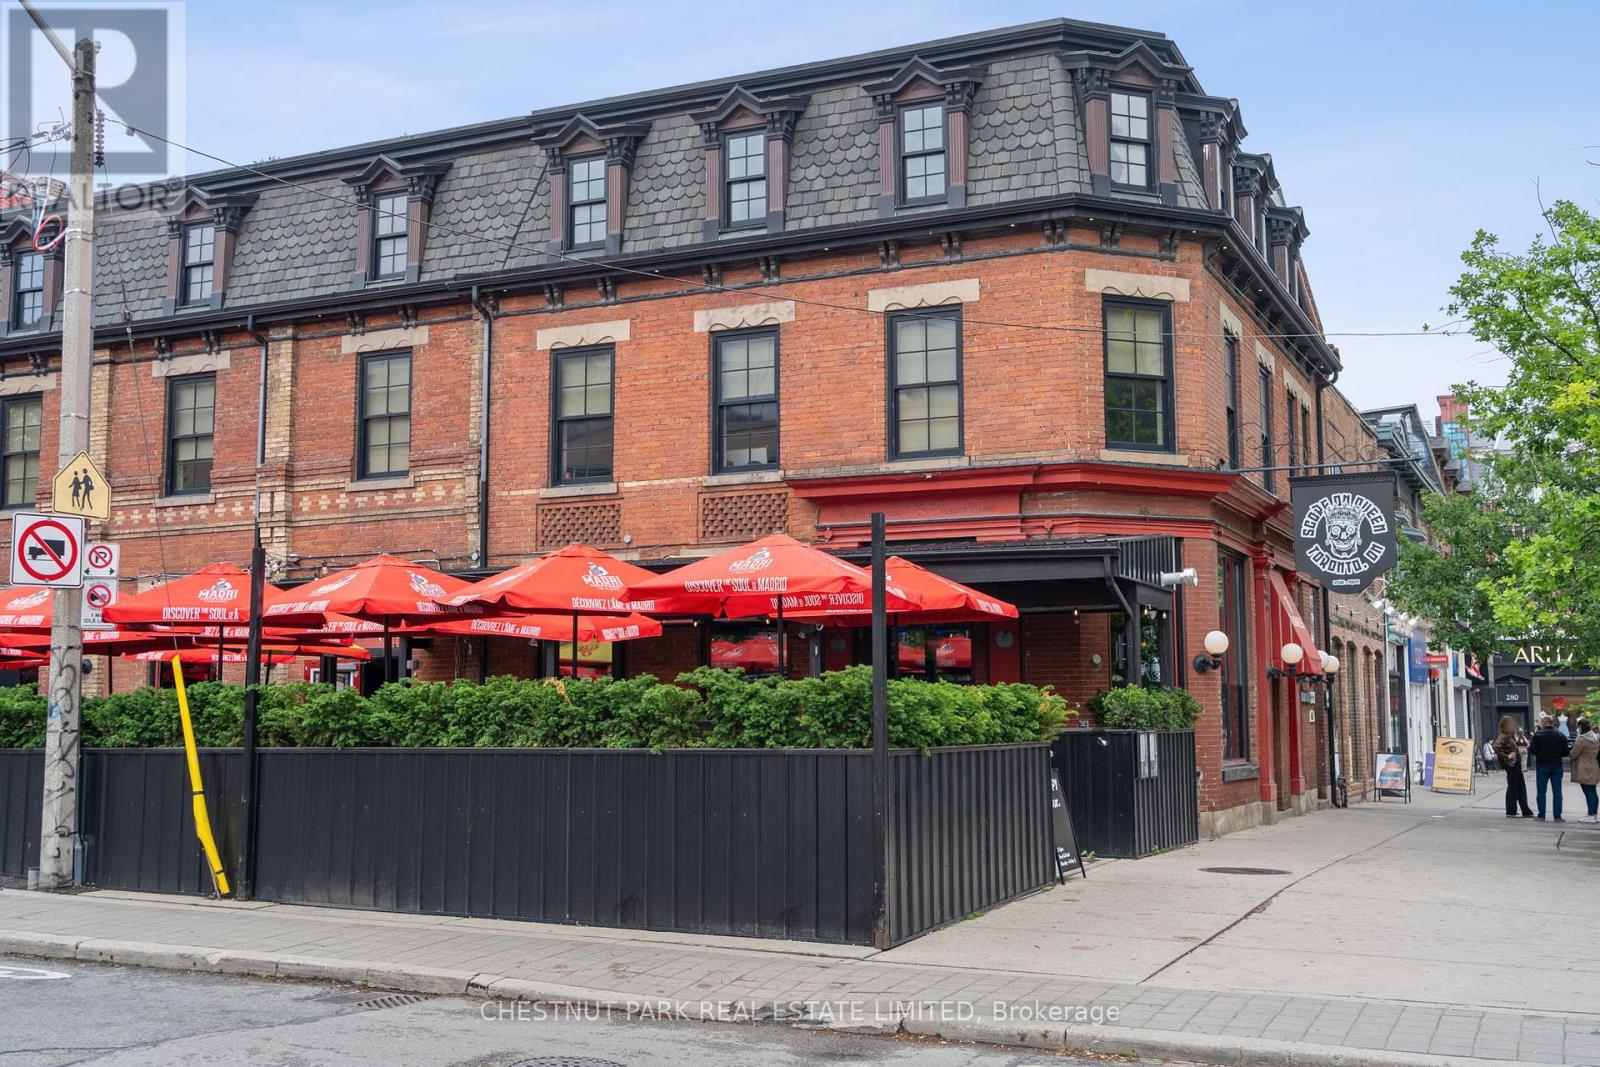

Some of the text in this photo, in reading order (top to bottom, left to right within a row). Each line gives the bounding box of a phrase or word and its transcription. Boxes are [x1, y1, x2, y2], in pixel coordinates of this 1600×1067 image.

[1332, 493, 1352, 507] ON
[1353, 494, 1388, 534] QUEEN
[1363, 541, 1386, 564] ON
[684, 579, 723, 592] DISCOVER
[731, 577, 751, 592] SOUL
[757, 576, 788, 592] MADRID
[162, 607, 200, 620] DISCOVER
[209, 607, 227, 620] SOUL
